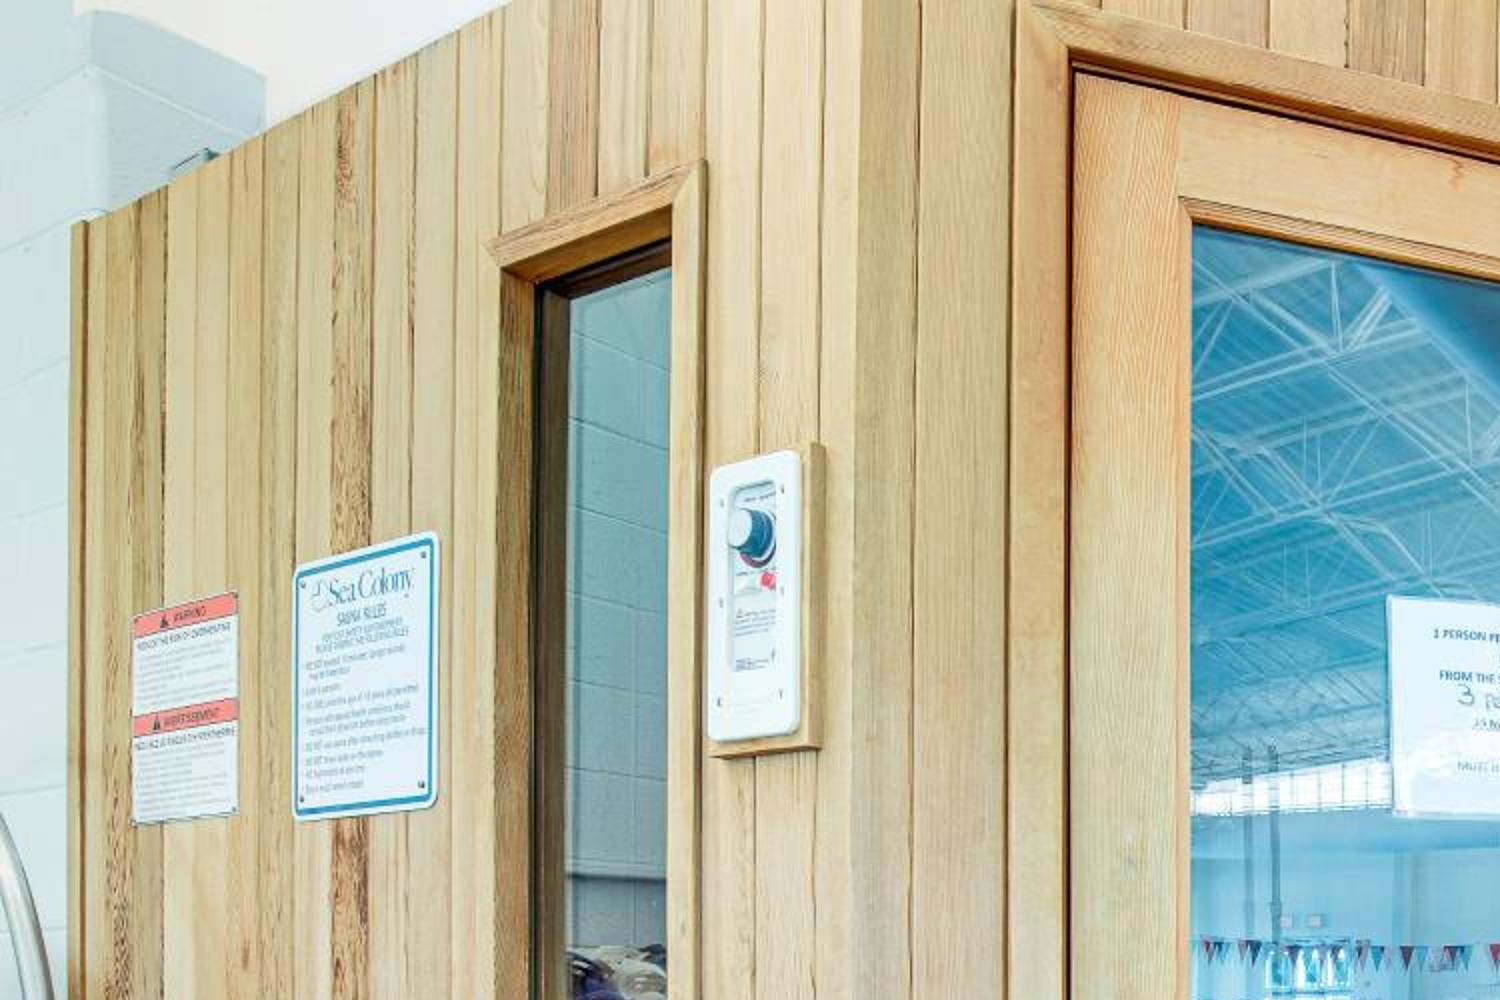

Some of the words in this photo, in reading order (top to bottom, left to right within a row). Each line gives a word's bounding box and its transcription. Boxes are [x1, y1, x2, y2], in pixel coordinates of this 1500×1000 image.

[329, 578, 356, 606] Sea
[359, 567, 412, 598] Colony
[1443, 629, 1487, 641] PERSON
[1439, 670, 1472, 682] FROM
[1476, 673, 1495, 685] THE
[1456, 683, 1475, 706] 3
